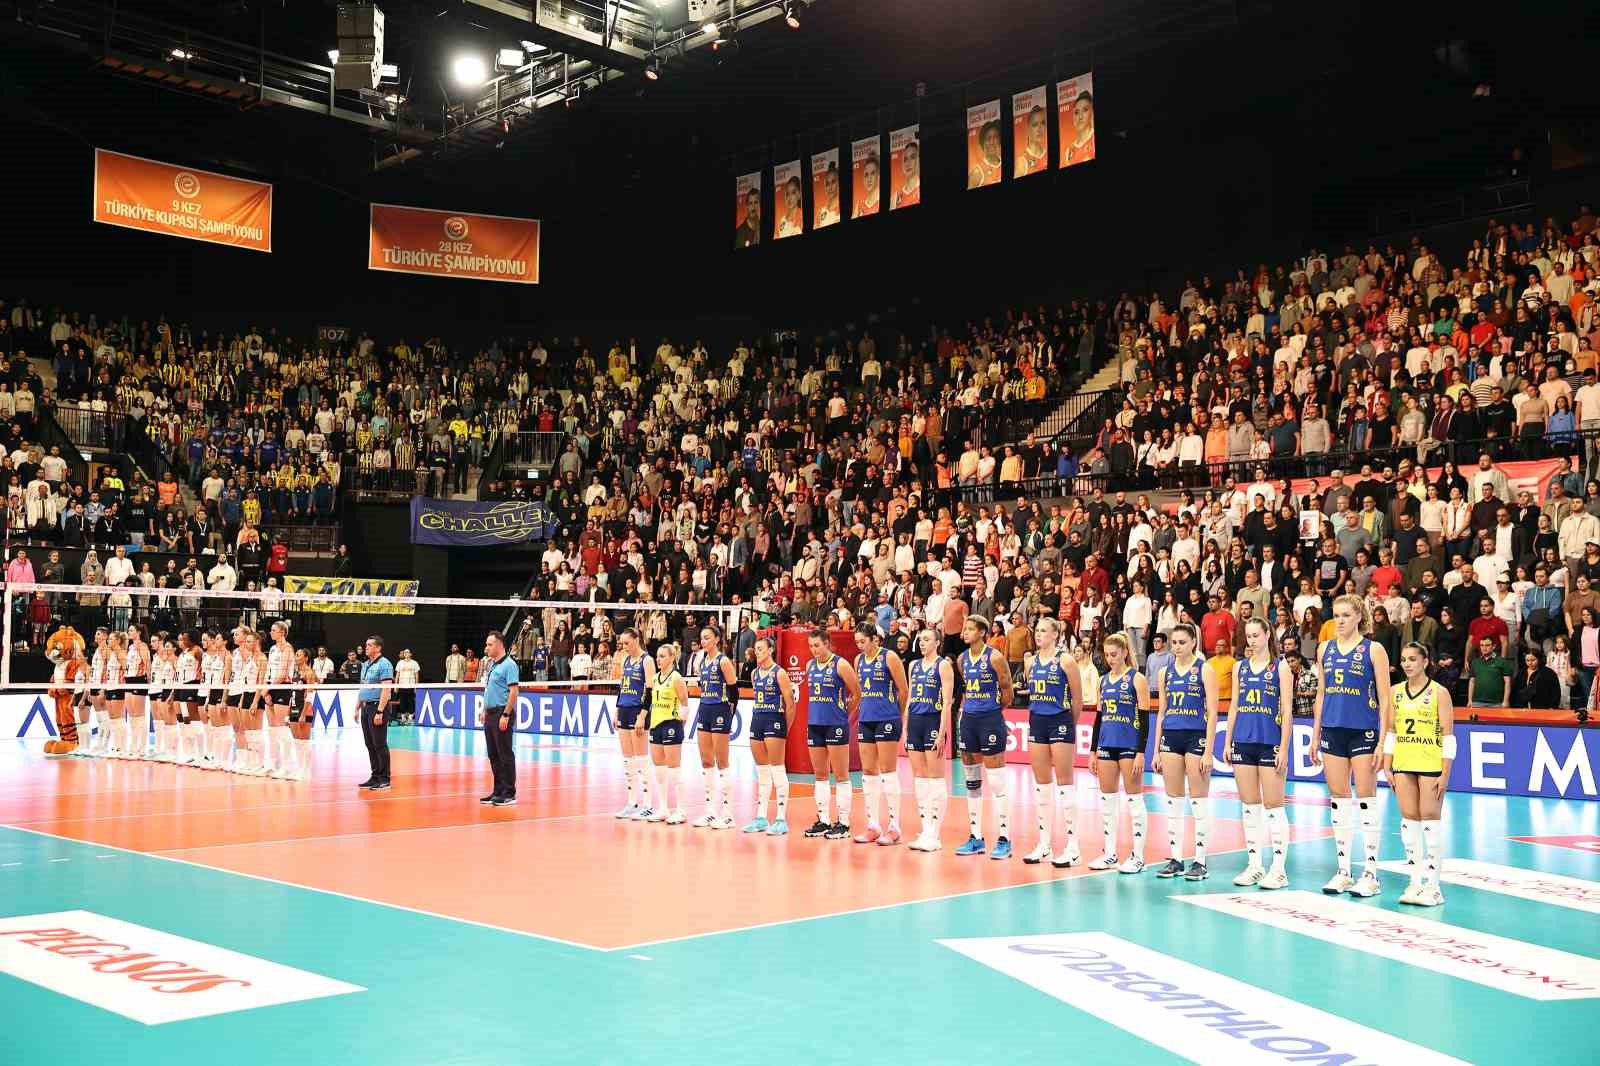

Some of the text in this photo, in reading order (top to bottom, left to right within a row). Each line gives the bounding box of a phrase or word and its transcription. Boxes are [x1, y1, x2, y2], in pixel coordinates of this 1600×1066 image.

[172, 200, 202, 214] 9 KEZ
[104, 199, 263, 241] TÜRKİYE KUPASI ŞAMPİYONU
[439, 240, 473, 254] 28 KEZ
[383, 245, 526, 275] TÜRKİYE ŞAMPİYONU
[1334, 668, 1344, 684] 5
[864, 678, 871, 690] 4
[916, 683, 923, 696] 9
[966, 679, 980, 692] 44
[1033, 680, 1046, 693] 10
[757, 691, 764, 702] 8
[1171, 691, 1184, 706] 17
[1245, 688, 1262, 704] 41
[418, 690, 584, 735] ACIBDEM
[1104, 699, 1117, 713] 15
[1405, 719, 1416, 734] 2
[0, 928, 252, 993] PEGASUS
